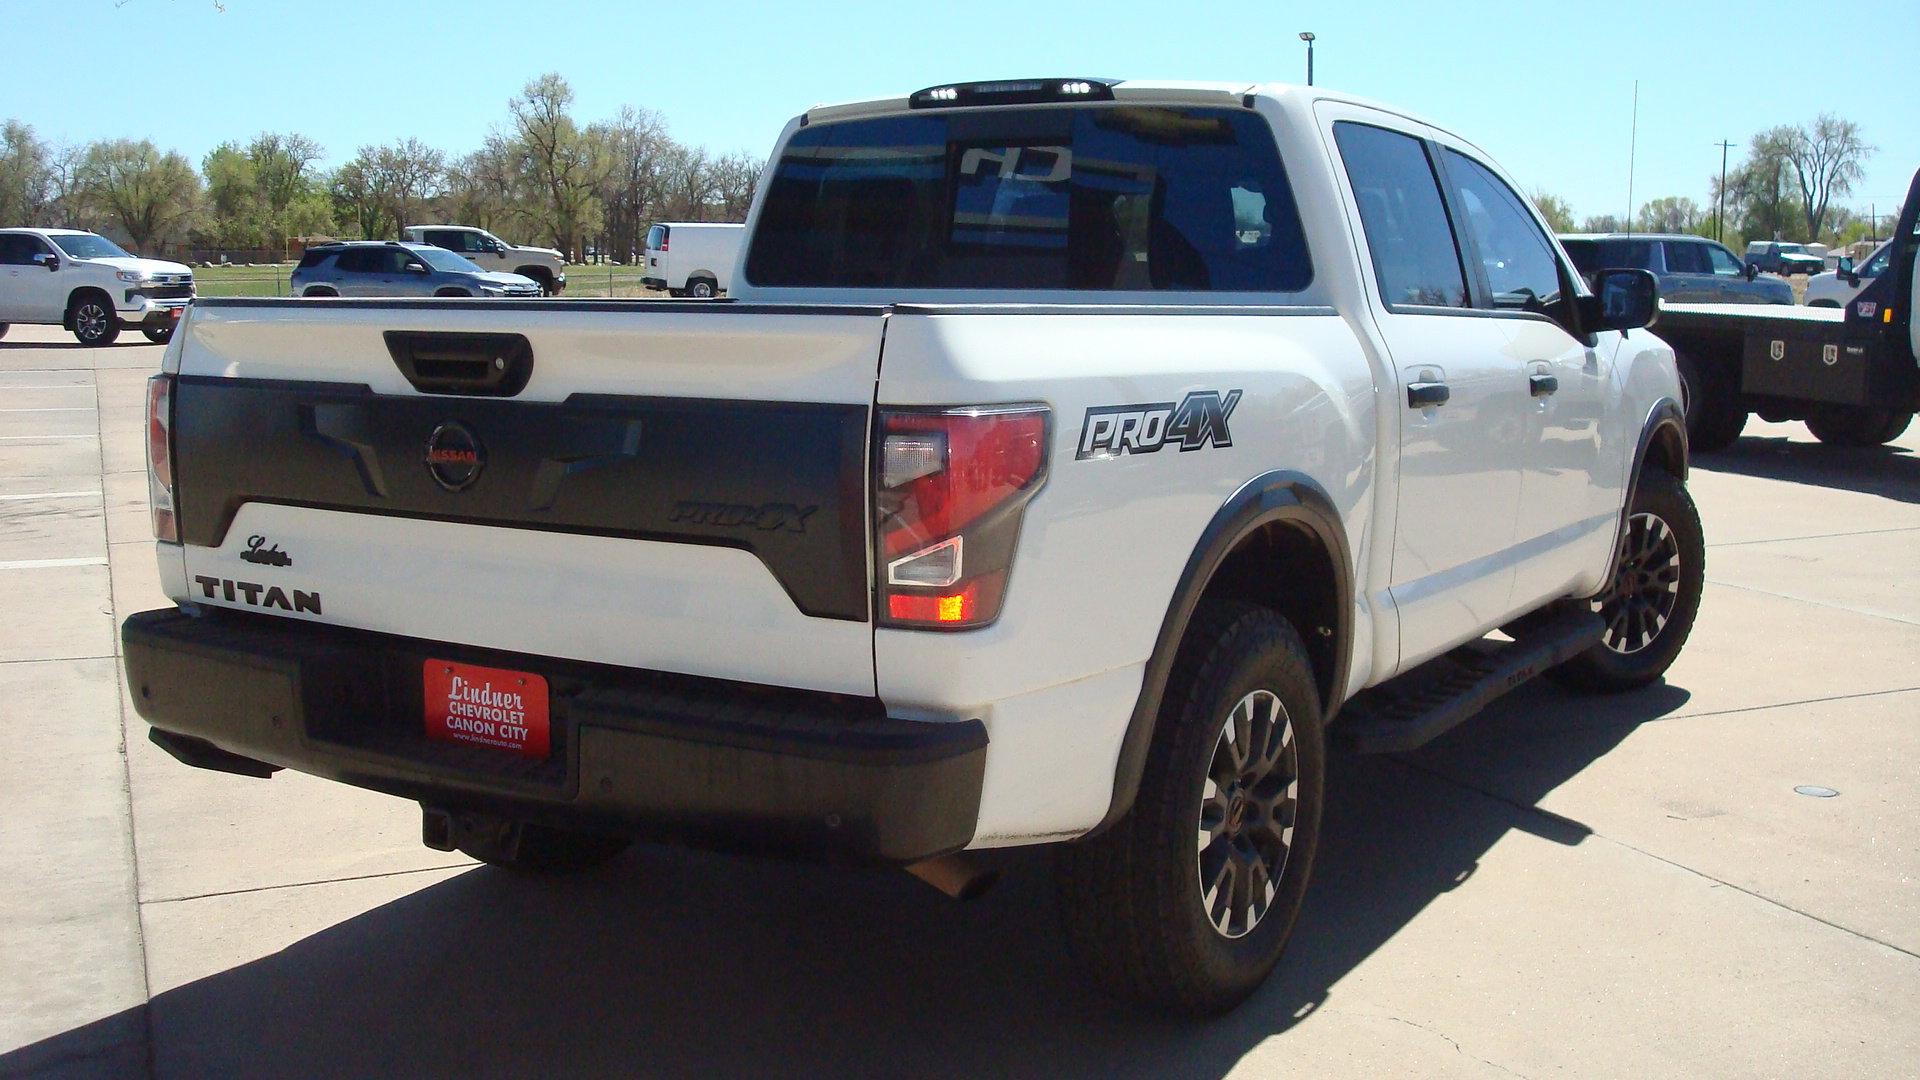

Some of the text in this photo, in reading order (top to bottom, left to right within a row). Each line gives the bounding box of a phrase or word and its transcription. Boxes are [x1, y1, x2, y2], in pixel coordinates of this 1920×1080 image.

[429, 449, 477, 463] NISSAN
[195, 575, 322, 615] TITAN
[448, 676, 524, 710] Lindner
[449, 701, 525, 725] CHEVROLET
[446, 716, 528, 741] CANON CITY
